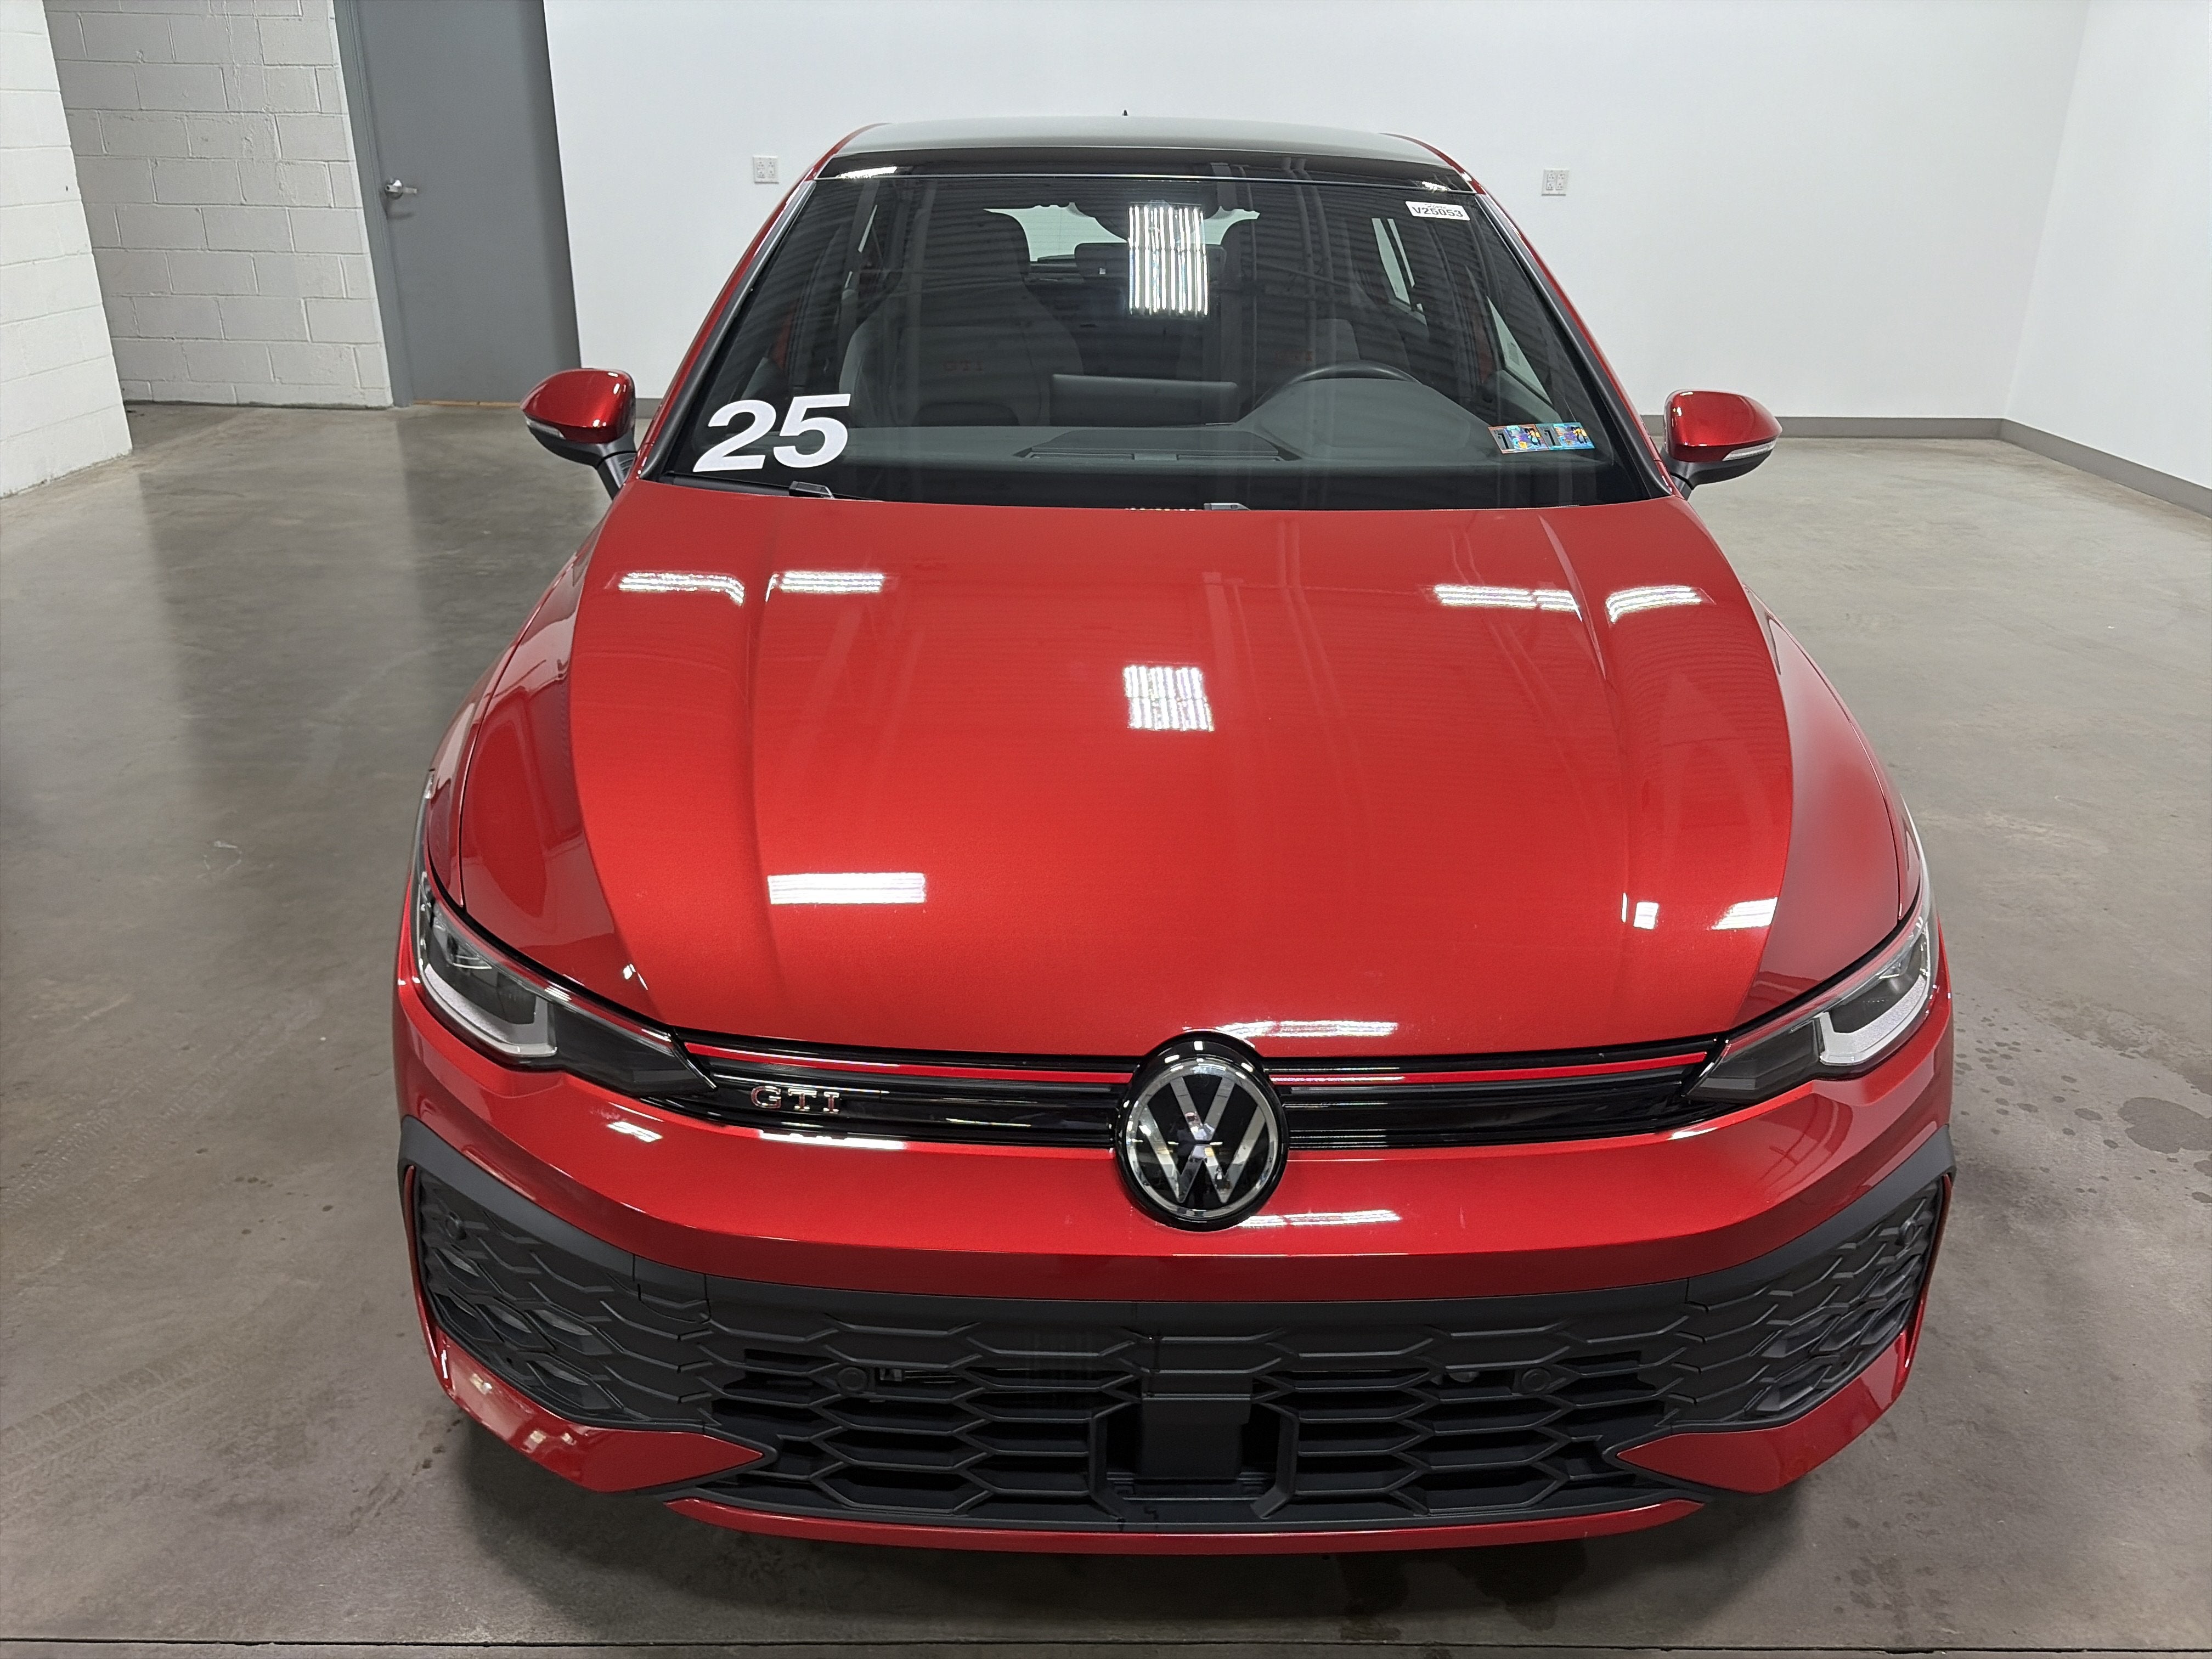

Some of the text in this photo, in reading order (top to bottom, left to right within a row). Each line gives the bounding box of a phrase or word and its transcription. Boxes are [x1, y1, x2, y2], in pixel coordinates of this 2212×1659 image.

[1412, 206, 1464, 217] V25053
[693, 393, 851, 472] 25
[751, 1086, 839, 1114] GTI
